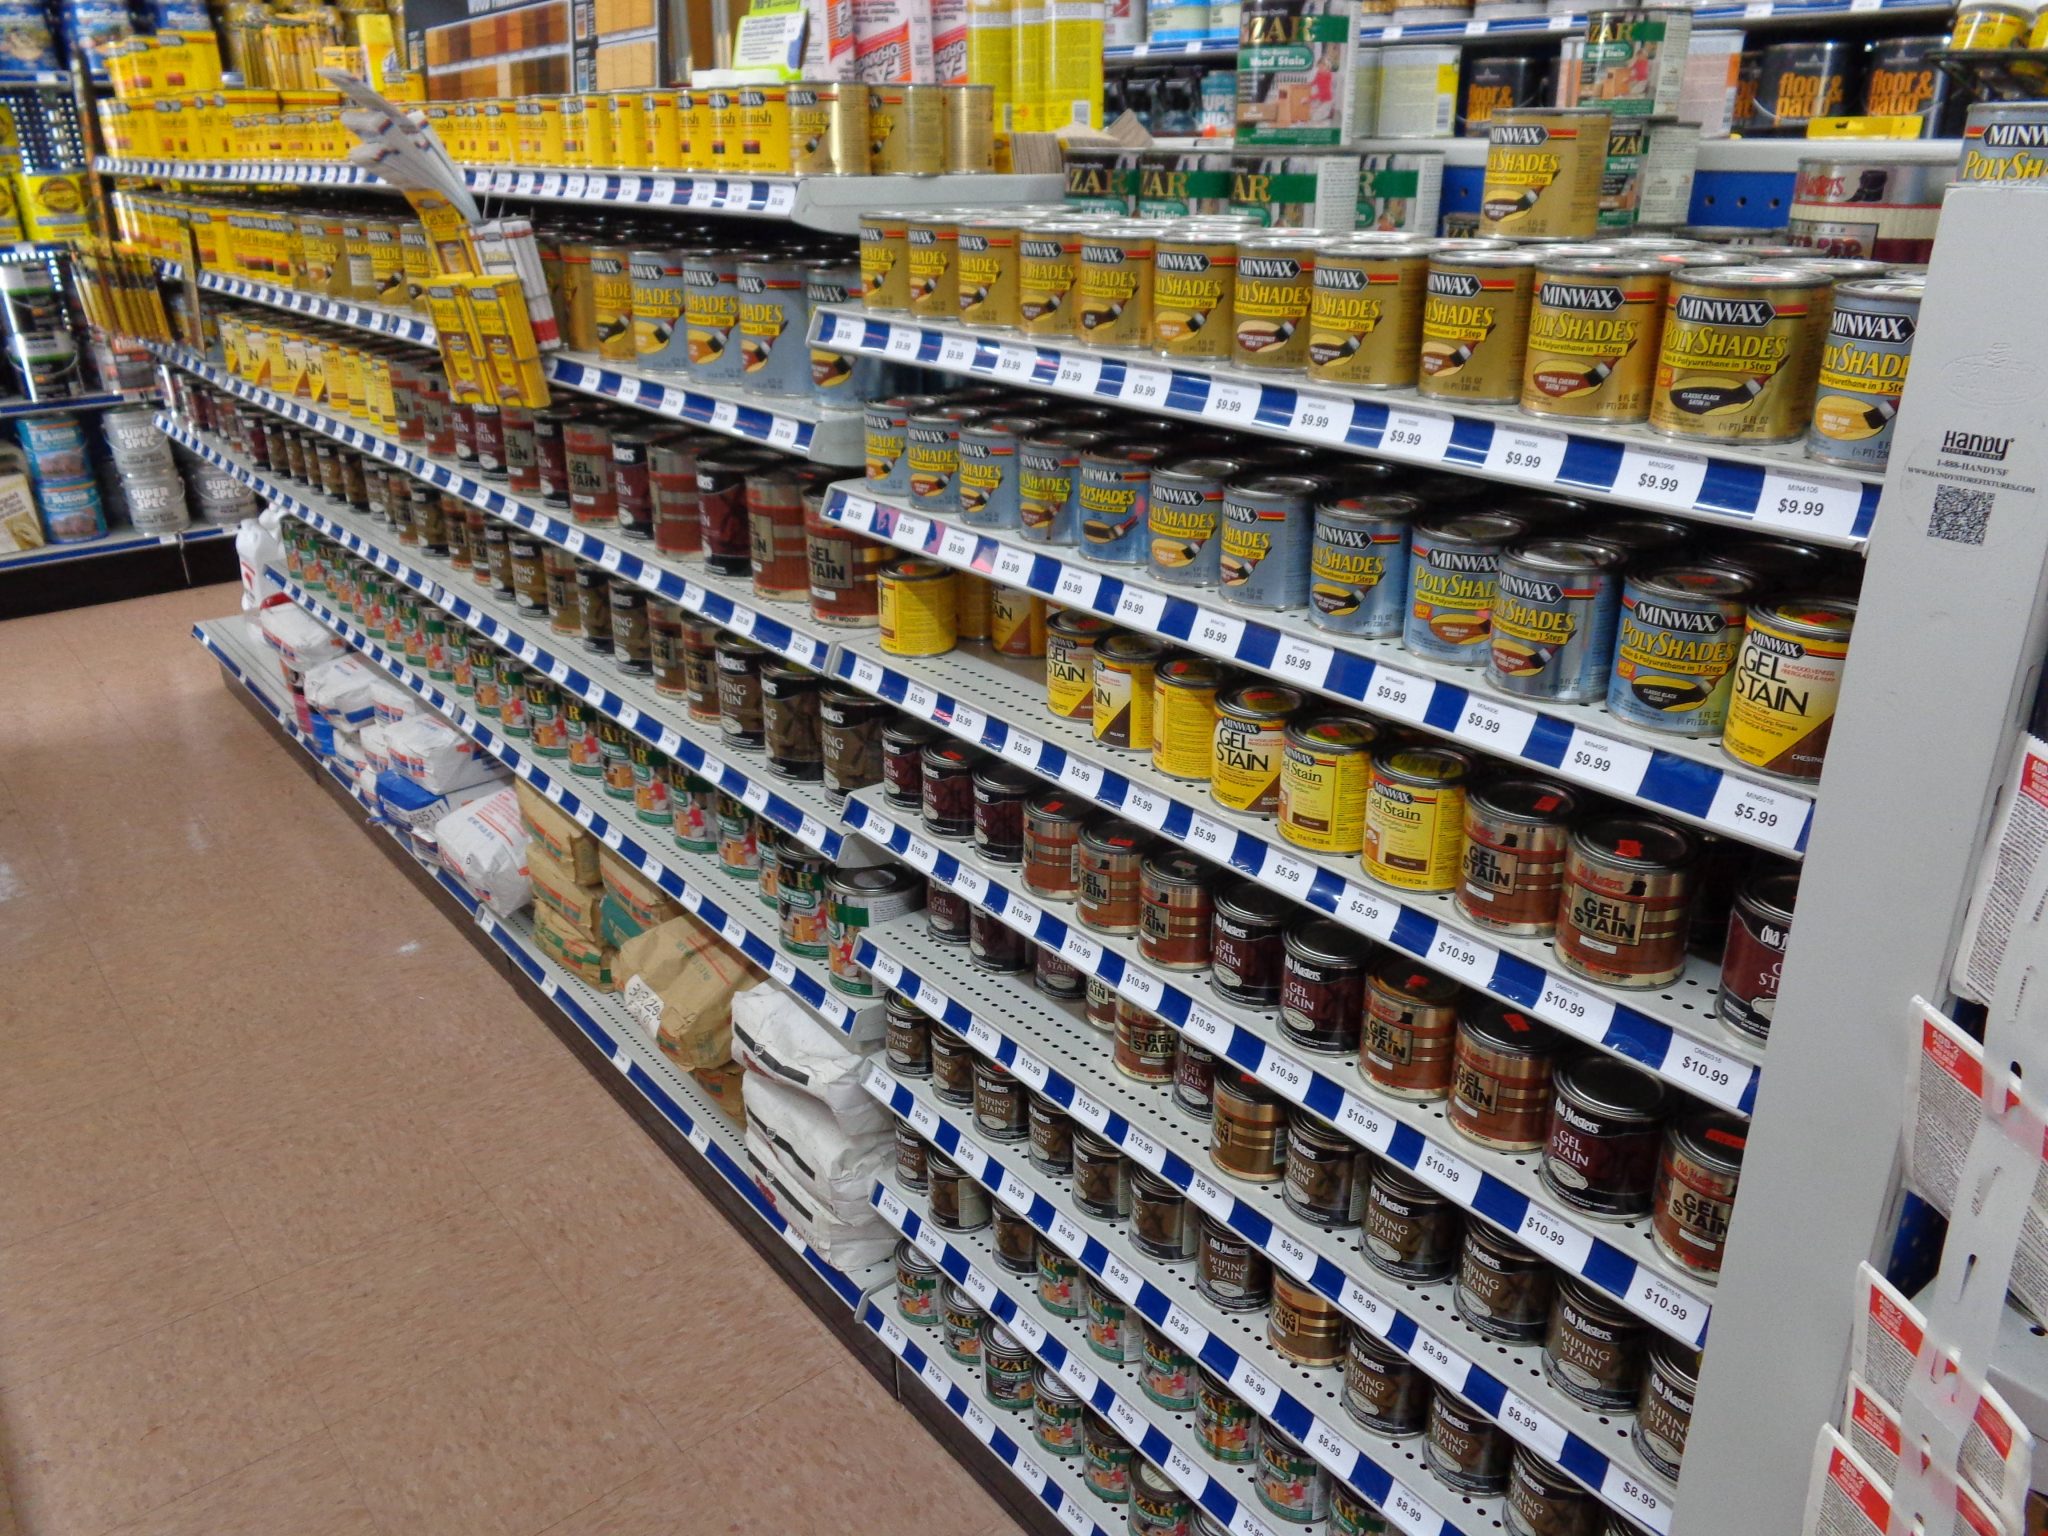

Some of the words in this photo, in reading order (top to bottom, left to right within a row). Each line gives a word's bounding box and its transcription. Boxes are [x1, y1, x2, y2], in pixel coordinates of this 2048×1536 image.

[1278, 55, 1306, 66] Stain
[1919, 69, 1934, 99] &
[1988, 123, 2048, 147] MINW
[1068, 168, 1128, 195] ZAR
[1239, 258, 1296, 279] MINWAX
[1541, 284, 1615, 309] MINWAX
[1679, 297, 1764, 324] MINWAX
[1831, 310, 1905, 341] MINWAX
[1603, 344, 1622, 355] Step
[1678, 357, 1730, 369] Polyurethane
[1750, 361, 1772, 372] Step
[1301, 414, 1330, 429] $9.99
[1389, 430, 1422, 446] $9.99
[1504, 450, 1542, 469] $9.99
[1637, 473, 1679, 493] $9.99
[1152, 485, 1202, 505] MINWAX
[1777, 497, 1825, 517] $9.99
[1430, 550, 1498, 572] MINWAX
[1357, 576, 1376, 585] Step
[1500, 571, 1554, 601] MINWAX
[1638, 603, 1716, 632] MINWAX
[1203, 626, 1228, 644] $9.99
[1544, 633, 1564, 645] Step
[1752, 630, 1800, 657] MINWAX
[1284, 653, 1313, 671] $9.99
[1639, 655, 1686, 671] Polyurethane
[1704, 664, 1723, 674] Step
[1744, 645, 1787, 685] GEL
[1377, 685, 1408, 704] $9.99
[1735, 665, 1810, 717] STAIN
[1223, 717, 1258, 735] MINWAX
[1467, 711, 1501, 733] $9.99
[1219, 727, 1253, 753] GEL
[1216, 742, 1269, 773] STAIN
[1574, 750, 1612, 773] $9.99
[1291, 760, 1323, 783] Stain
[1375, 781, 1412, 804] MINWAX
[1384, 800, 1422, 822] Stain
[1734, 803, 1779, 828] $5.99
[1193, 826, 1217, 844] $5.99
[910, 844, 929, 860] $10.99
[1469, 845, 1501, 870] GEL
[957, 873, 978, 891] $10.99
[1275, 864, 1301, 883] $5.99
[1462, 856, 1511, 887] STAIN
[1350, 899, 1379, 920] $5.99
[1583, 897, 1627, 923] GEL
[1573, 906, 1637, 940] STAIN
[1215, 945, 1242, 968] STAIN
[1219, 939, 1236, 956] GEL
[1438, 940, 1476, 966] $10.99
[1125, 974, 1151, 993] $10.99
[1293, 962, 1322, 982] Masters
[1284, 988, 1315, 1011] STAIN
[1289, 981, 1309, 999] GEL
[1544, 989, 1586, 1019] $10.99
[970, 1023, 990, 1042] $10.99
[1189, 1012, 1217, 1035] $10.99
[1369, 1019, 1400, 1045] GEL
[1133, 1039, 1175, 1054] STAIN
[1147, 1033, 1175, 1045] GEL
[1020, 1058, 1042, 1077] $12.99
[1269, 1061, 1300, 1086] $10.99
[1456, 1062, 1484, 1091] GEL
[1681, 1055, 1730, 1087] $10.99
[977, 1091, 1011, 1109] WIPING
[979, 1101, 1007, 1116] STAIN
[1078, 1097, 1100, 1118] $12.99
[1346, 1108, 1379, 1133] $10.99
[1555, 1098, 1565, 1120] Old
[1565, 1107, 1601, 1135] Masters
[1129, 1132, 1154, 1155] $12.99
[1559, 1129, 1582, 1151] GEL
[1552, 1136, 1590, 1169] STAIN
[1425, 1155, 1461, 1183] $10.99
[1196, 1178, 1217, 1200] $8.99
[1370, 1184, 1380, 1202] Old
[1380, 1193, 1411, 1217] Masters
[1683, 1191, 1723, 1220] GEL
[1368, 1203, 1410, 1236] WIPING
[1369, 1217, 1402, 1244] STAIN
[1525, 1216, 1566, 1246] $10.99
[1281, 1239, 1304, 1261] $8.99
[1473, 1243, 1501, 1271] Masters
[1208, 1252, 1249, 1273] WIPING
[1211, 1263, 1244, 1282] STAIN
[1110, 1265, 1130, 1286] $8.99
[1352, 1290, 1378, 1314] $8.99
[1643, 1287, 1688, 1321] $10.99
[1168, 1314, 1190, 1337] $8.99
[1563, 1305, 1576, 1323] Old
[1576, 1315, 1612, 1342] Masters
[1422, 1340, 1449, 1365] $8.99
[1560, 1326, 1611, 1362] WIPING
[1561, 1340, 1602, 1371] STAIN
[1000, 1357, 1032, 1371] ZAR
[1244, 1373, 1267, 1397] $8.99
[1651, 1374, 1664, 1392] Old
[1116, 1403, 1135, 1426] $5.99
[1441, 1408, 1471, 1433] Masters
[1506, 1405, 1538, 1432] $8.99
[1648, 1412, 1687, 1445] STAIN
[1317, 1433, 1342, 1457] $8.99
[1171, 1455, 1192, 1476] $5.99
[1622, 1481, 1657, 1510] $8.99
[1396, 1497, 1422, 1523] $8.99
